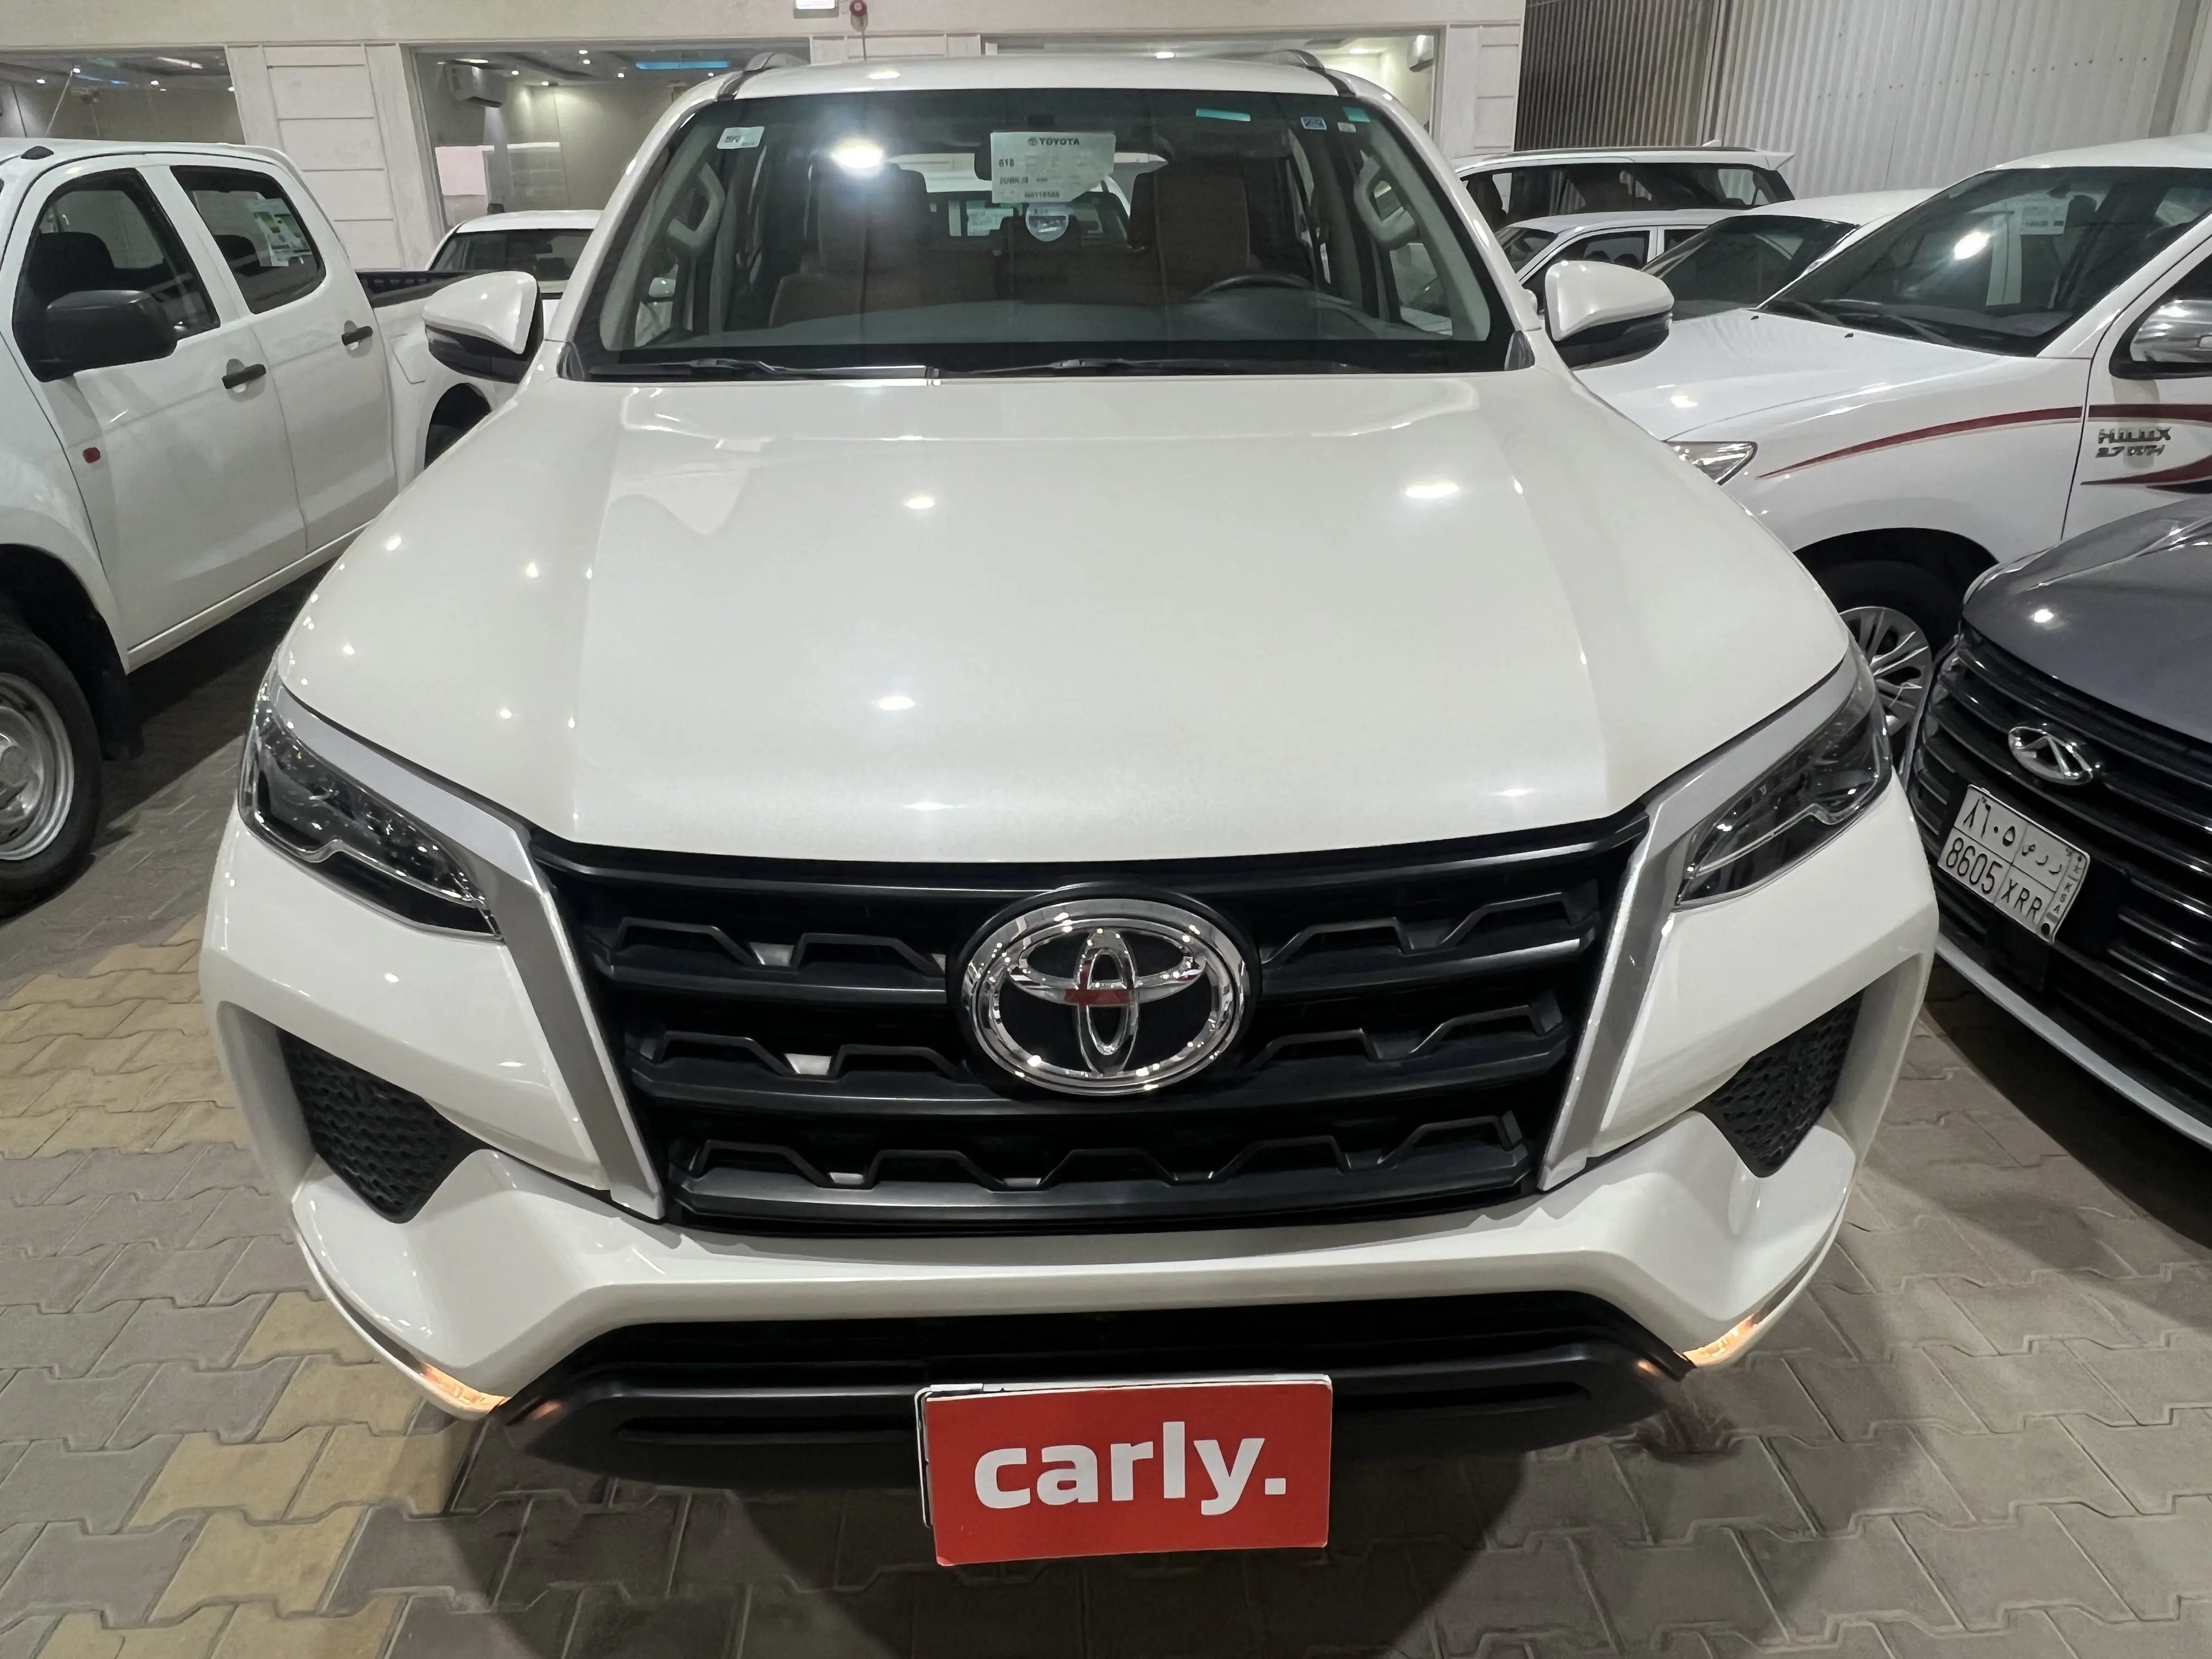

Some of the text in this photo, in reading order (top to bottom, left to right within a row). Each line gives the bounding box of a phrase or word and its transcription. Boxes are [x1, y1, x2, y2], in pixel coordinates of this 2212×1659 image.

[1039, 138, 1080, 146] TOYOTA
[2098, 427, 2172, 444] HILUX
[1946, 837, 2042, 923] 8605 XRR
[2053, 882, 2073, 915] KSA
[974, 1421, 1286, 1516] carly.
